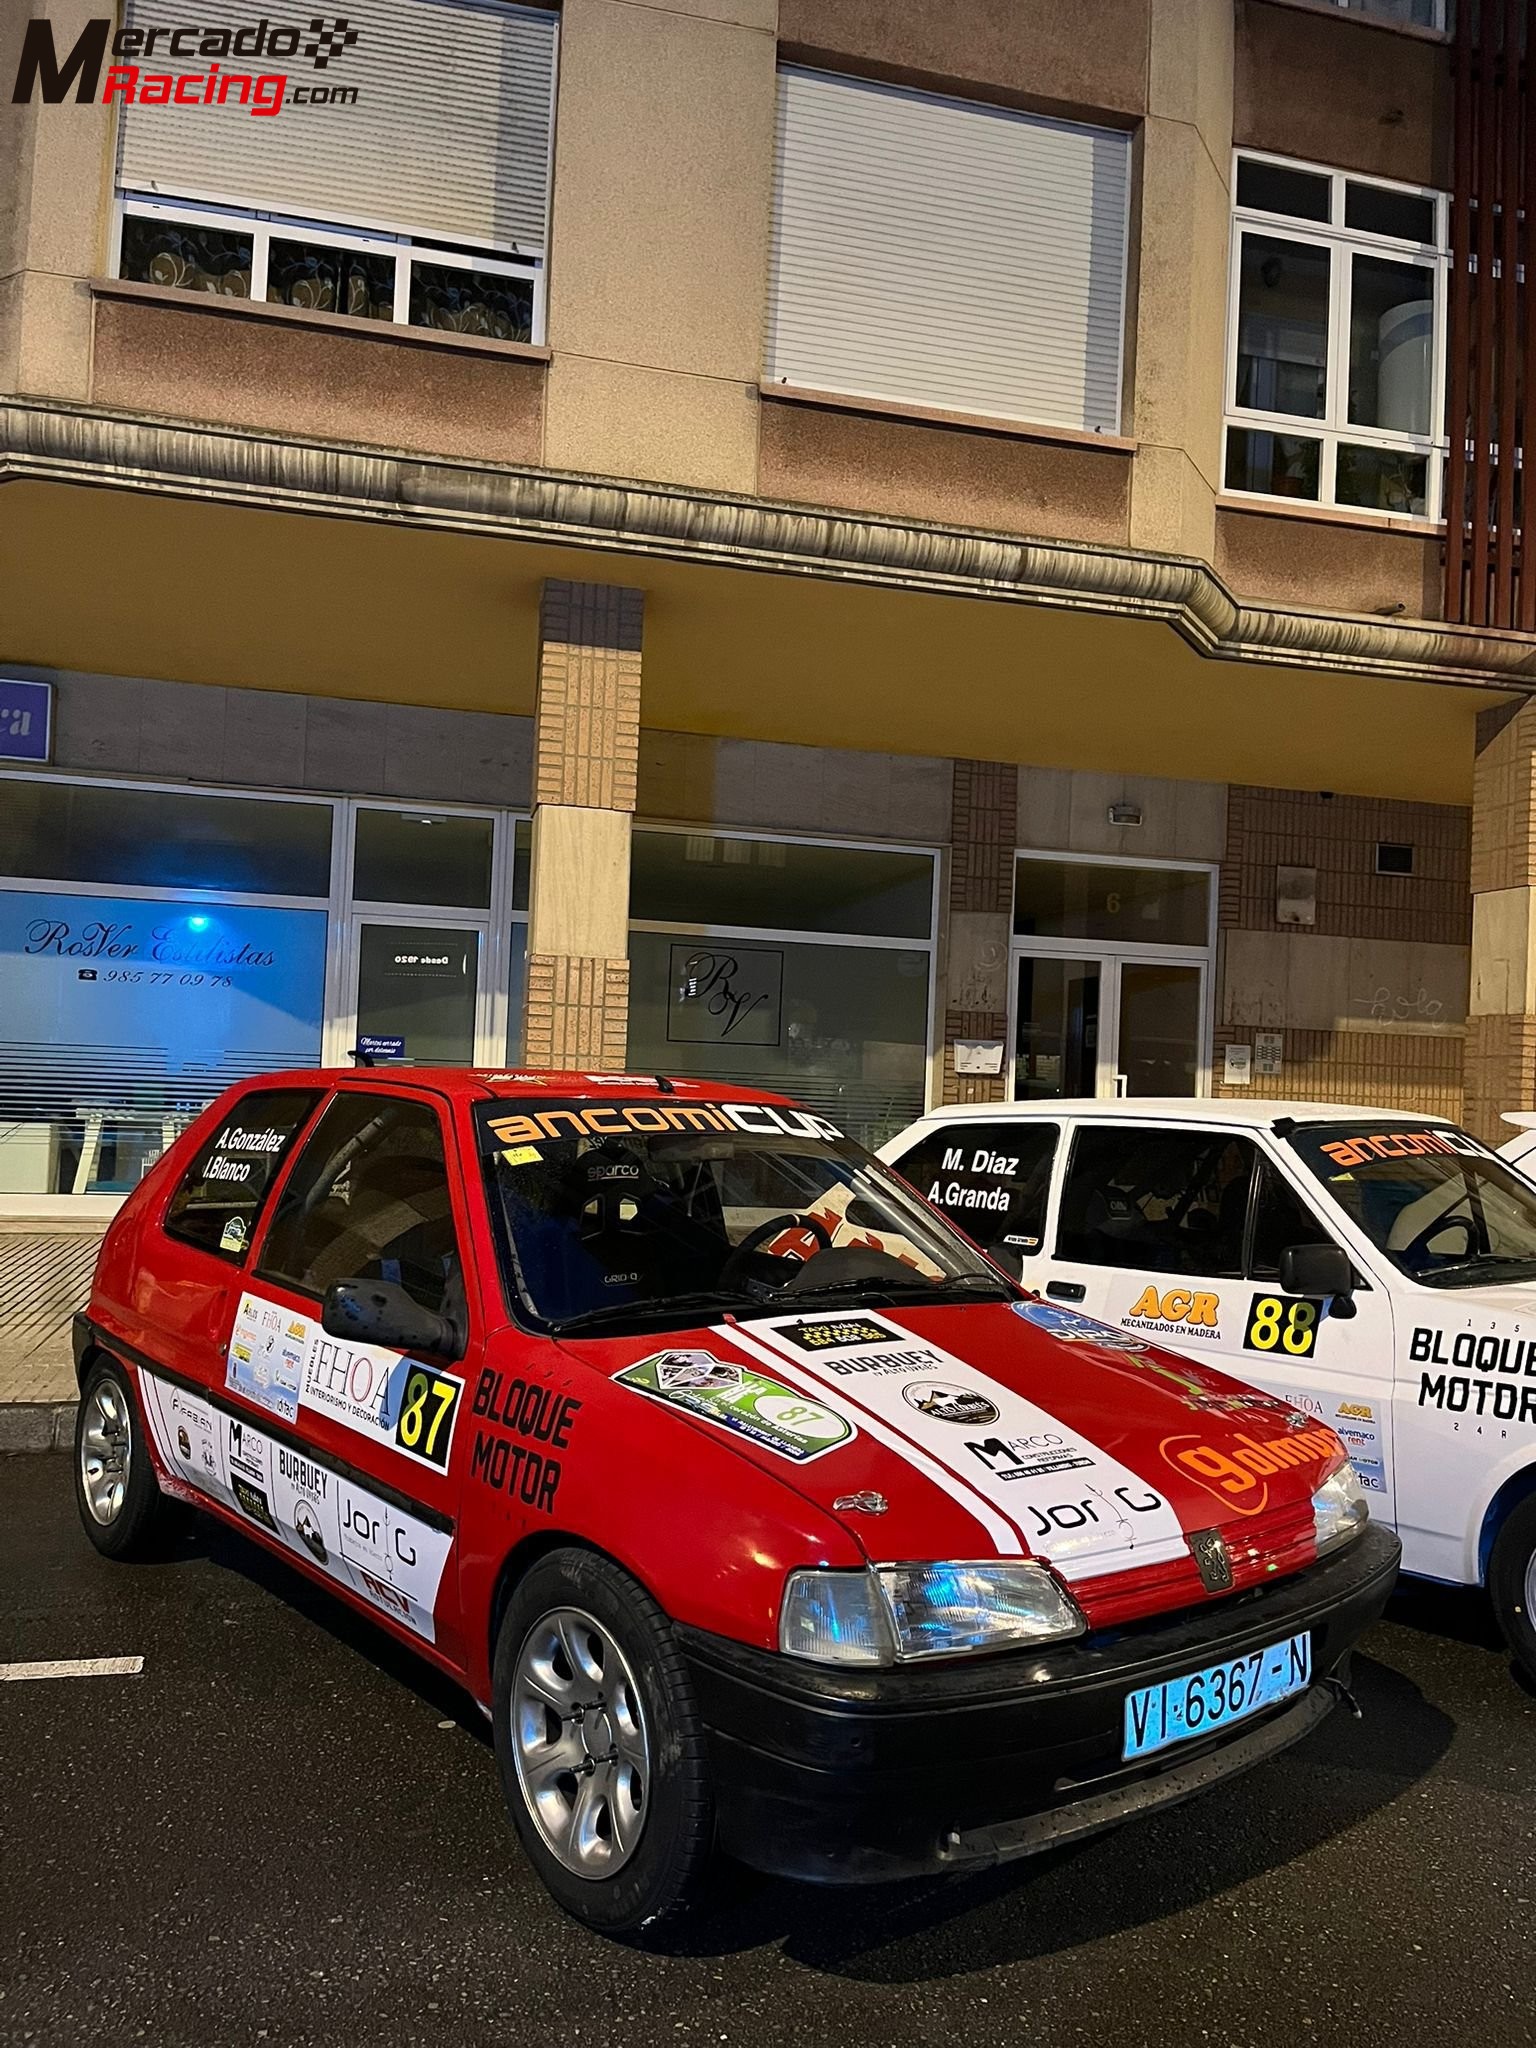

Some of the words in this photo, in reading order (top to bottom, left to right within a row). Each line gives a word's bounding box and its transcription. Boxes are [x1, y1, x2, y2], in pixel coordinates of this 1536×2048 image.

[150, 924, 276, 967] Estilistas
[102, 968, 144, 984] 985
[149, 971, 173, 984] 77
[179, 973, 204, 987] 09
[209, 974, 234, 988] 78
[214, 1126, 287, 1153] A.González
[202, 1155, 251, 1183] I.Blanco
[587, 1164, 640, 1182] sparco
[941, 1147, 965, 1172] M.
[970, 1149, 1020, 1176] Diaz
[927, 1180, 1011, 1212] A.Granda
[1128, 1285, 1221, 1328] AGR
[1120, 1317, 1175, 1334] MECANIZADOS
[1174, 1324, 1187, 1335] EN
[1186, 1327, 1222, 1340] MADERA
[1249, 1297, 1316, 1355] 88
[823, 1348, 944, 1377] BURBUEY
[1408, 1326, 1536, 1377] BLOQUE
[312, 1340, 391, 1417] FHOA
[309, 1386, 347, 1411] INTERIORISMO
[399, 1371, 457, 1456] 87
[471, 1366, 584, 1451] BLOQUE
[776, 1405, 825, 1427] 87
[1417, 1371, 1536, 1425] MOTOR
[963, 1433, 1064, 1471] MARCO
[279, 1447, 328, 1500] BURBUEY
[470, 1429, 563, 1516] MOTOR
